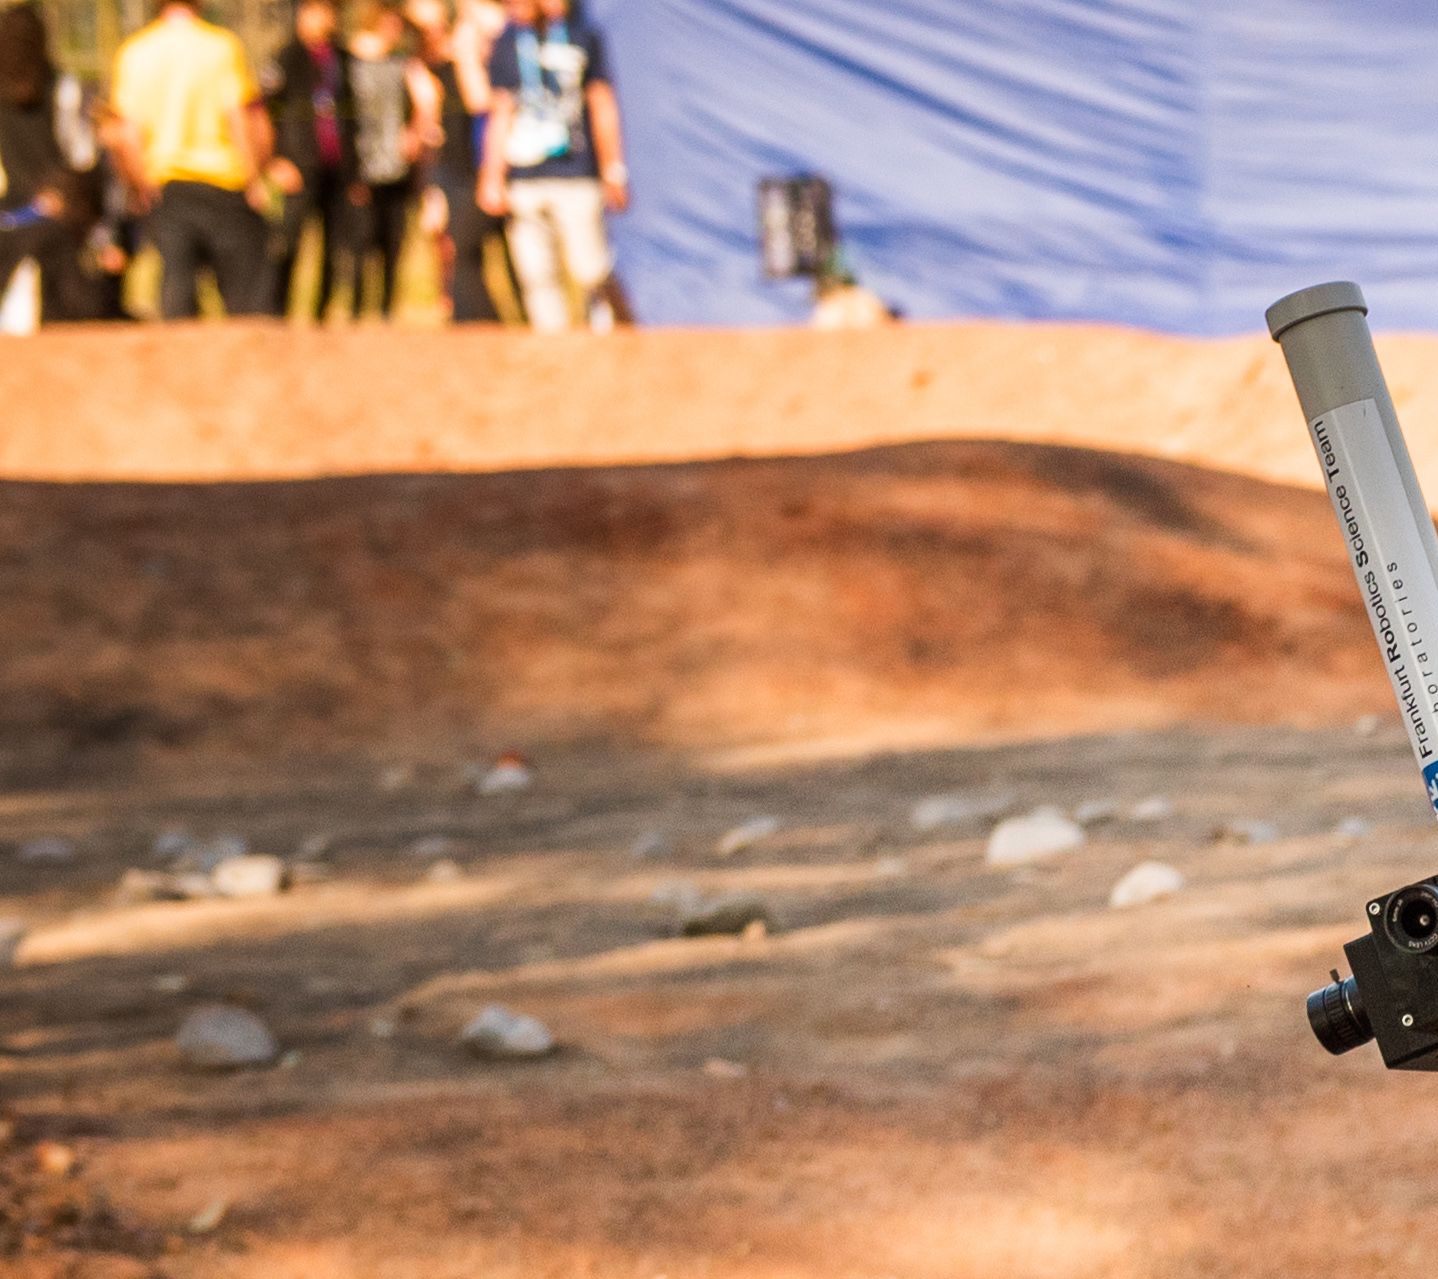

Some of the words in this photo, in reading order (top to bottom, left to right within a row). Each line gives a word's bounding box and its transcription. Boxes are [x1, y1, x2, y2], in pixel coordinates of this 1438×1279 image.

[1313, 420, 1340, 483] Team
[1335, 485, 1369, 567] Science
[1364, 570, 1401, 664] Robotics
[1394, 665, 1434, 759] Frankfurt
